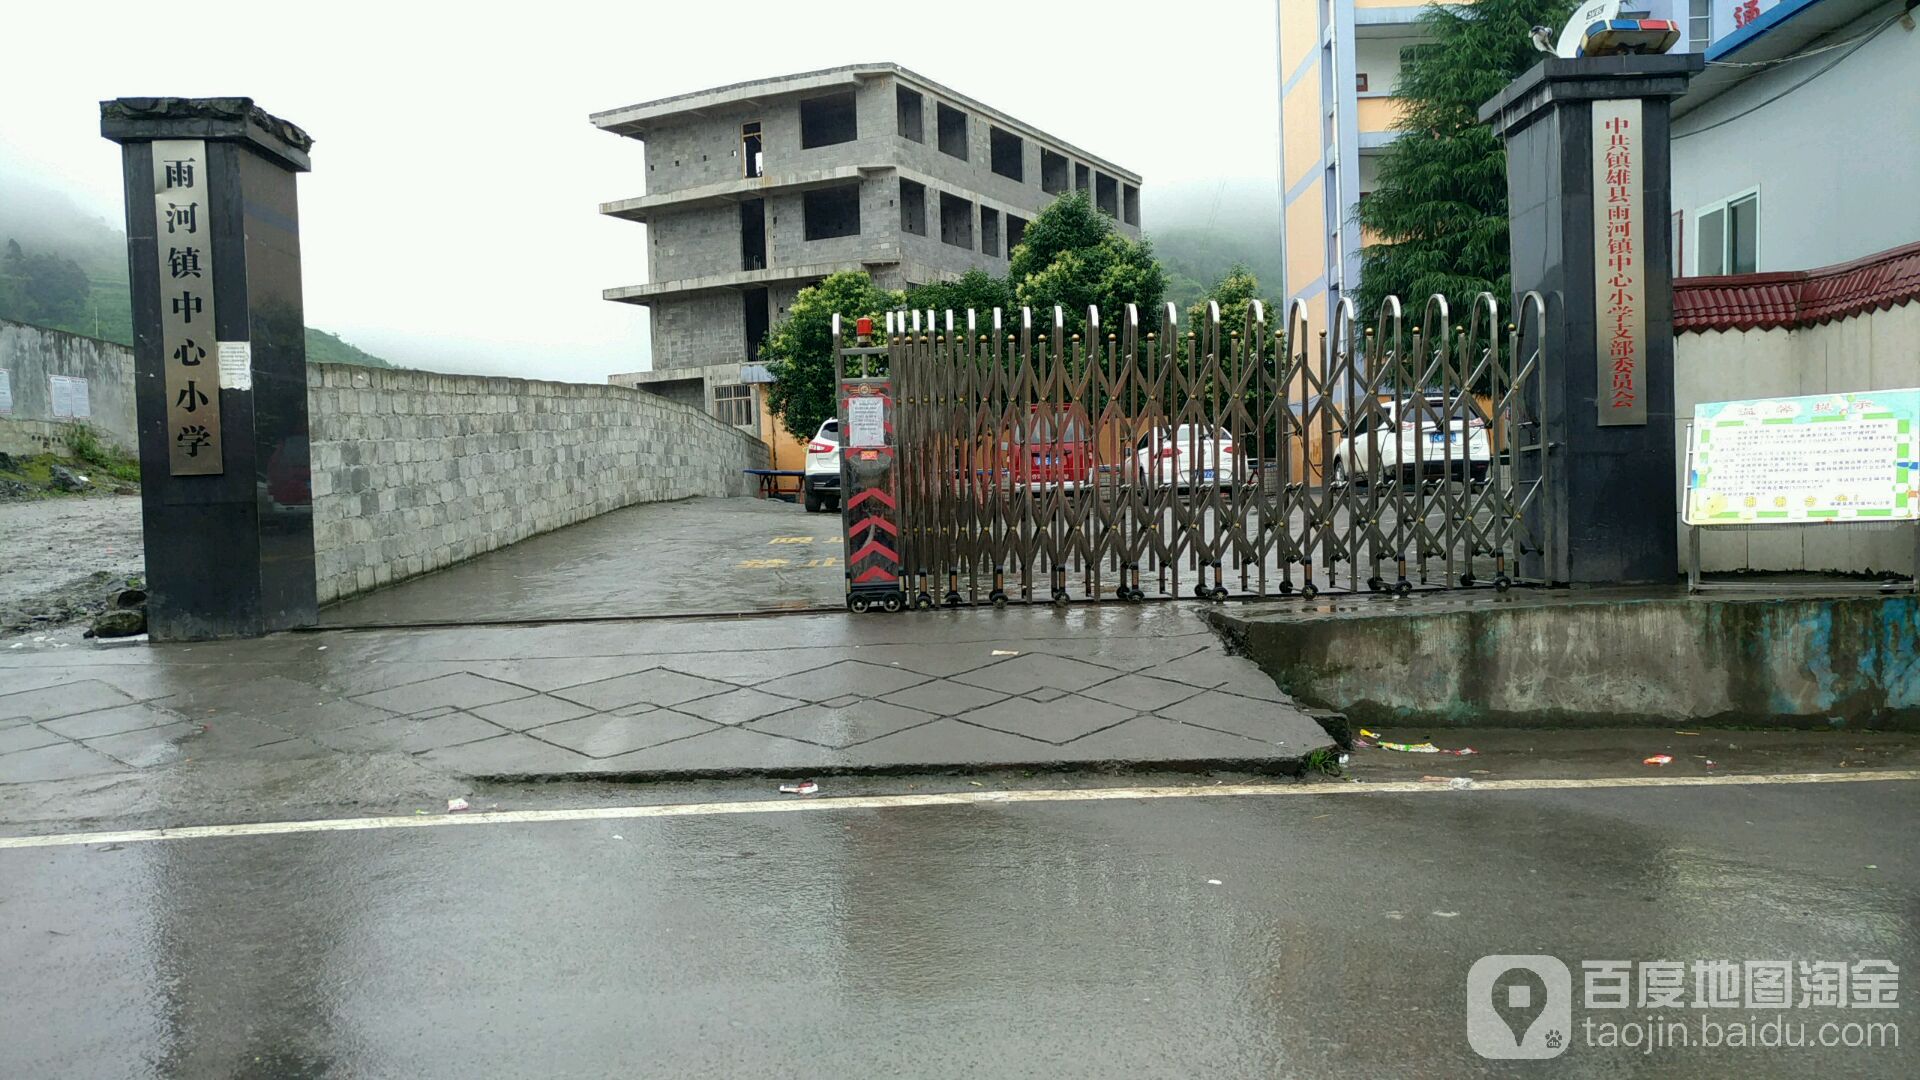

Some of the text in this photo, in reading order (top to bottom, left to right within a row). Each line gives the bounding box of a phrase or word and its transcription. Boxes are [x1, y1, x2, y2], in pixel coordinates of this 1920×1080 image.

[163, 158, 212, 458] 雨河镇中心小学
[1604, 117, 1635, 408] 中共镇雄县雨河镇中心小学支部委员会
